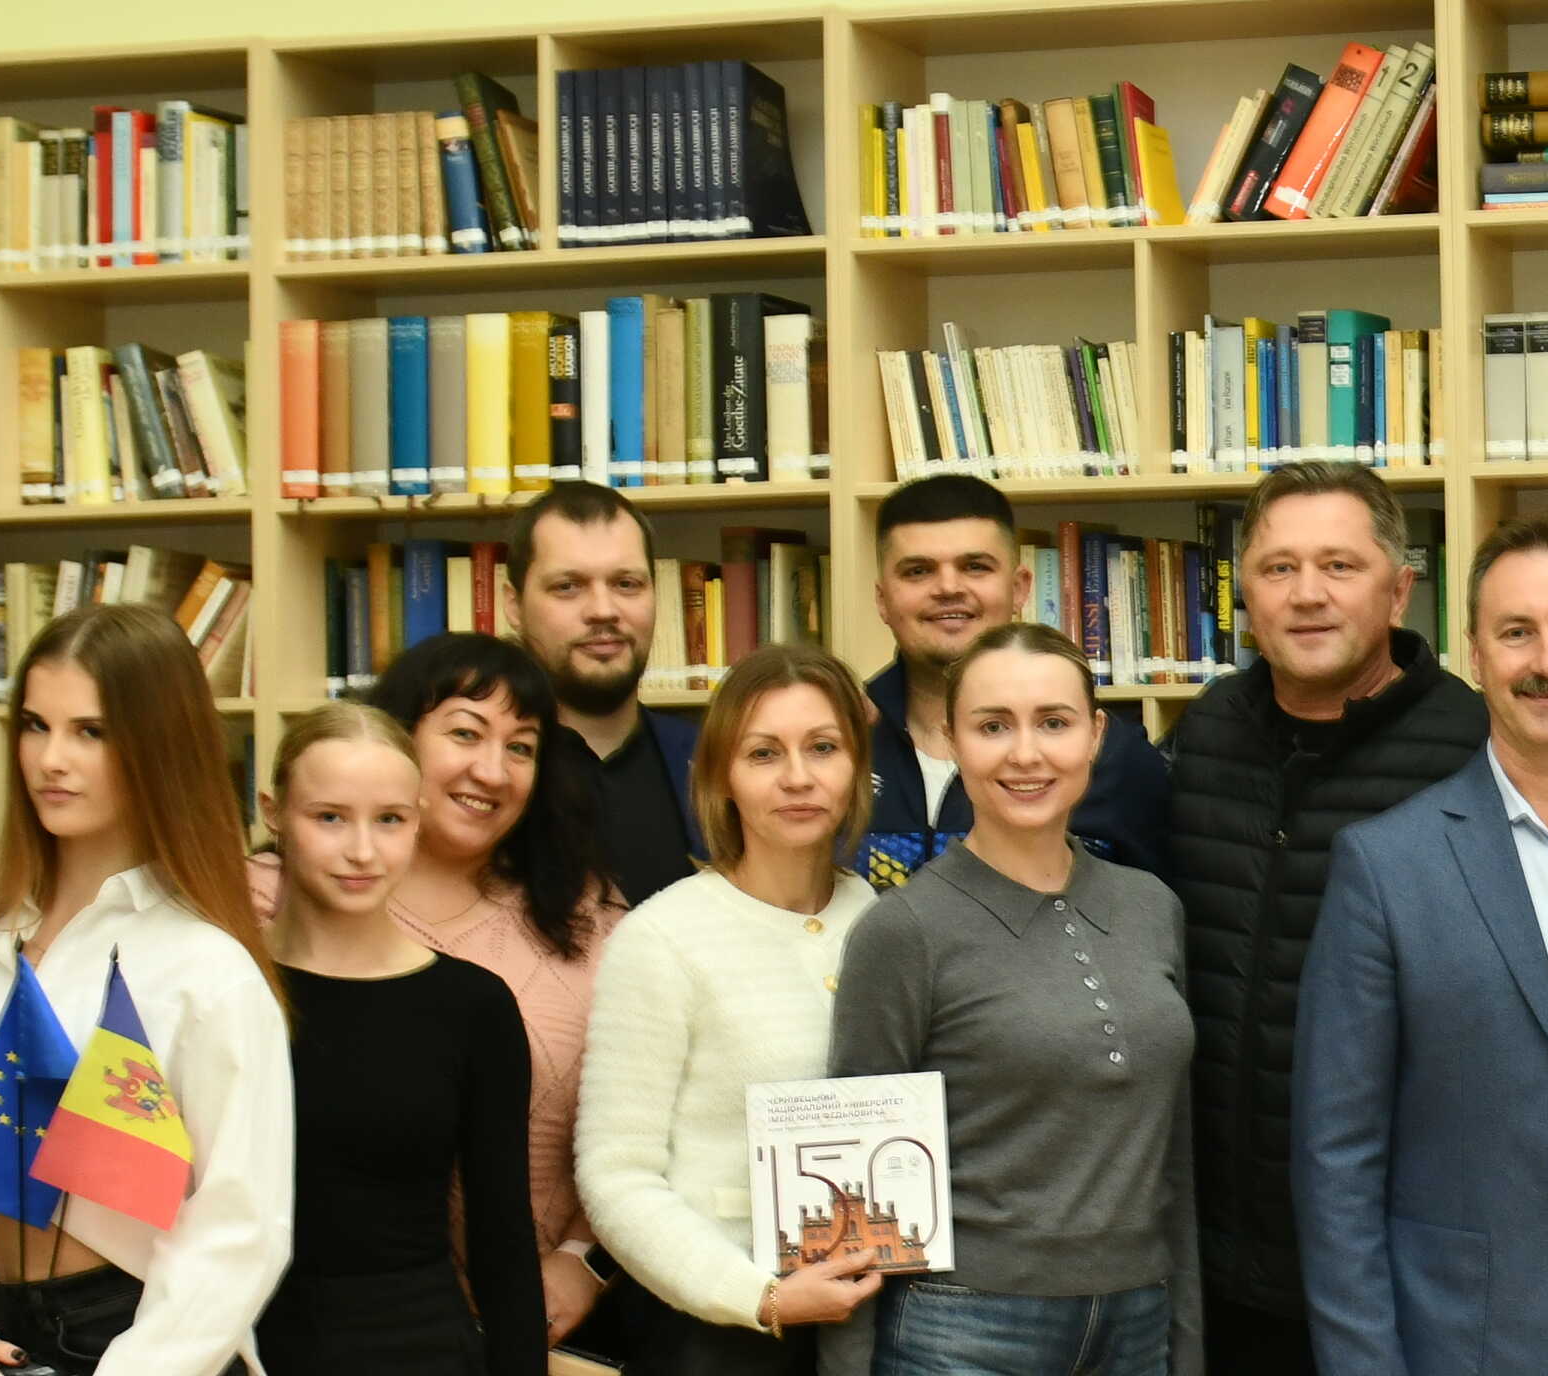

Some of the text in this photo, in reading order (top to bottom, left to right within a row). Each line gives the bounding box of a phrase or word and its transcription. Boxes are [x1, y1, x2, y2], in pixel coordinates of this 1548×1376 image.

[1376, 65, 1390, 88] 1
[1398, 62, 1419, 87] 2
[732, 354, 750, 452] Goethe-Zitate
[1217, 559, 1233, 631] FLASHBACK OST
